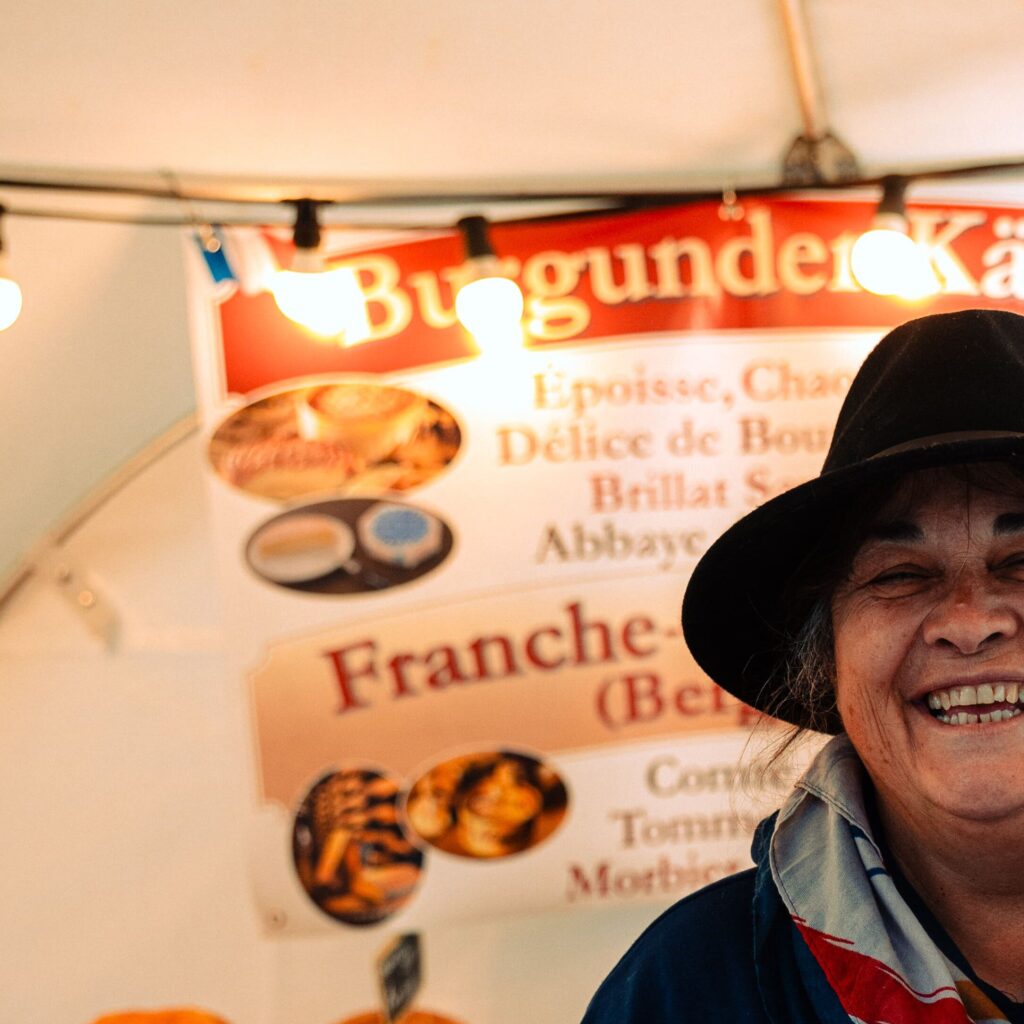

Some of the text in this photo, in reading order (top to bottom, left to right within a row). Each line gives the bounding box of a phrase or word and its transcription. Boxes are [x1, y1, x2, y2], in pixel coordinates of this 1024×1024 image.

[496, 420, 652, 466] Délice
[667, 418, 721, 457] de
[589, 470, 728, 514] Brillat
[534, 520, 707, 570] Abbaye
